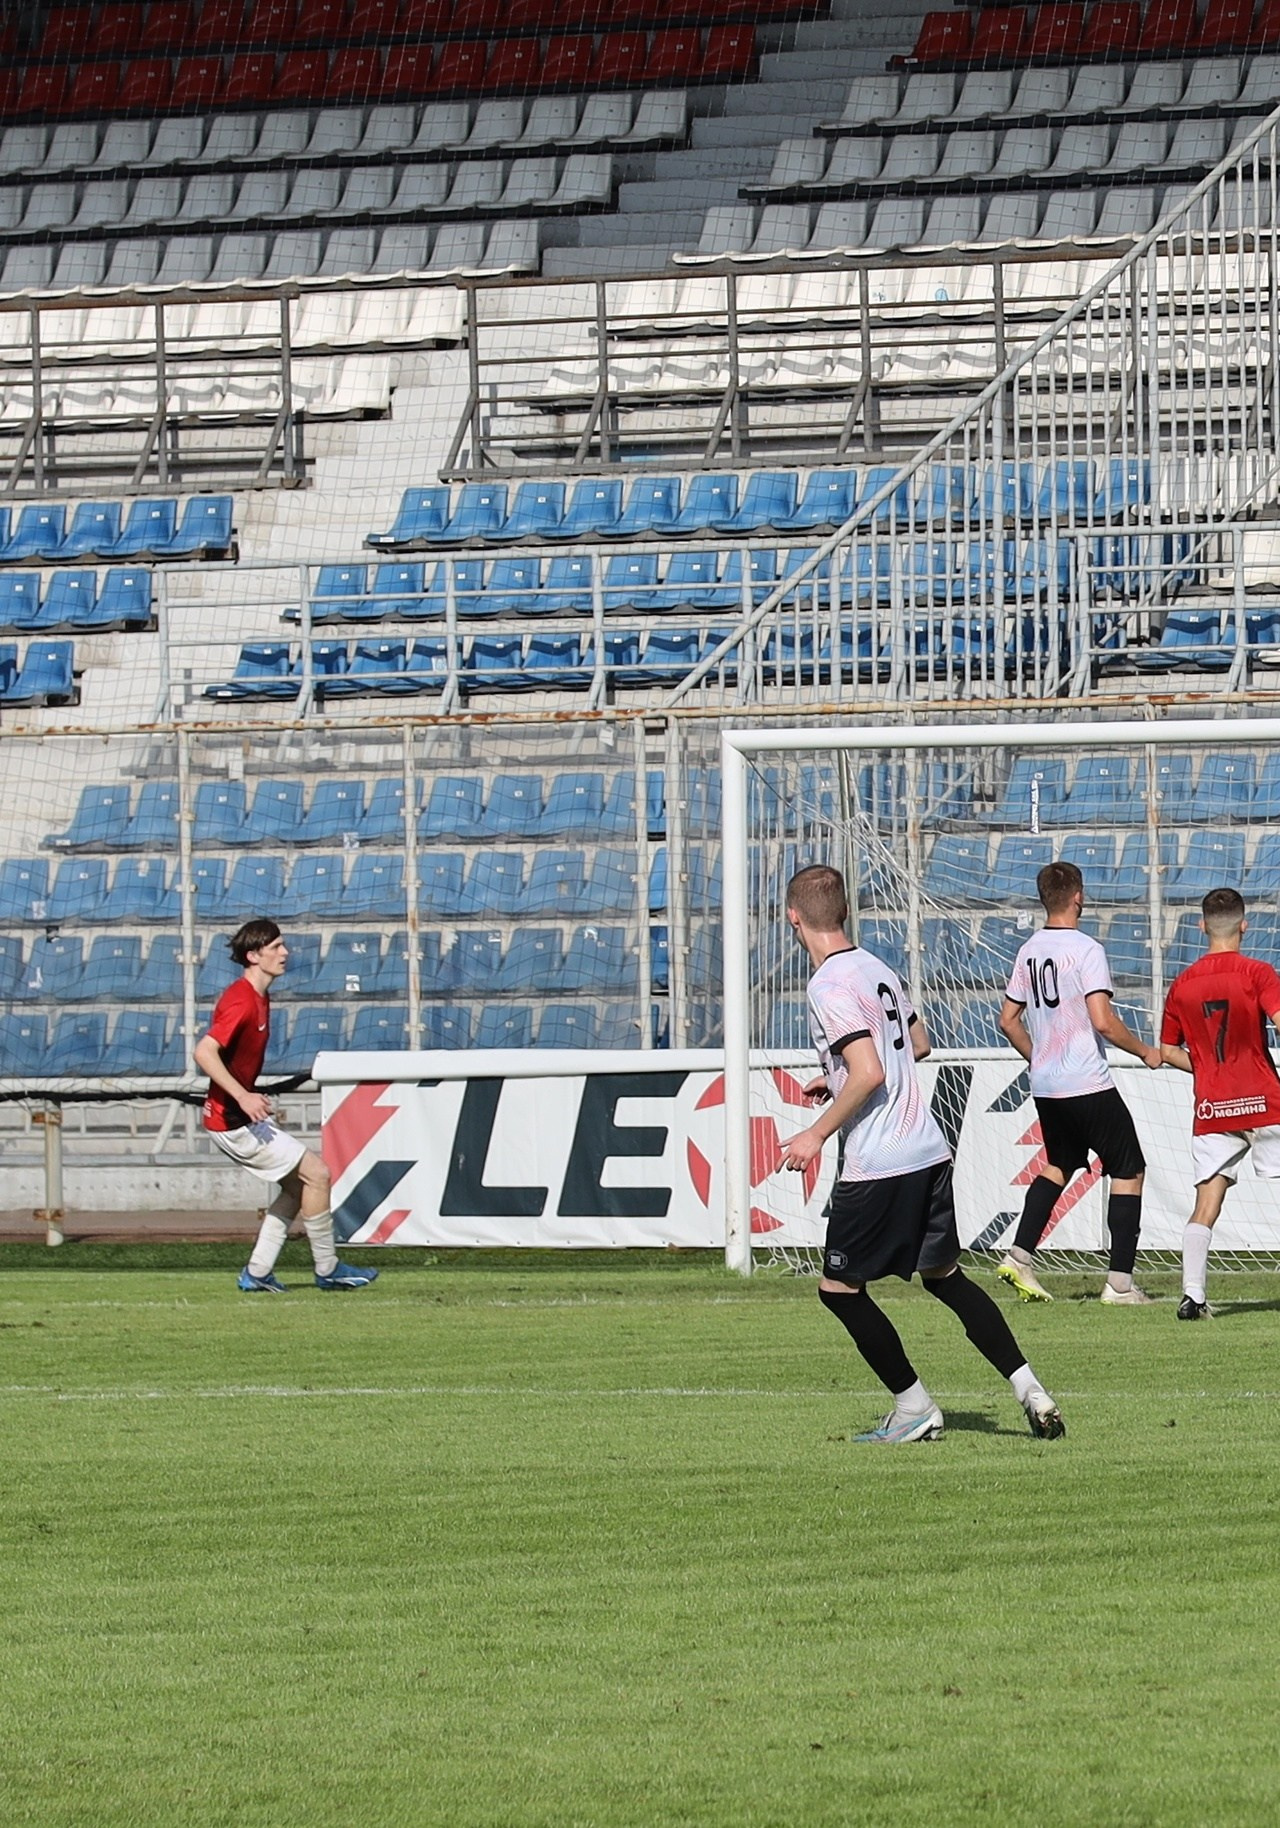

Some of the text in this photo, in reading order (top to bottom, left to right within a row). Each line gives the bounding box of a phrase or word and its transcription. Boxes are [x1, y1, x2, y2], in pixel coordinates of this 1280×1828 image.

[1027, 957, 1060, 1009] 10
[877, 982, 904, 1050] 9
[1202, 999, 1229, 1064] 7
